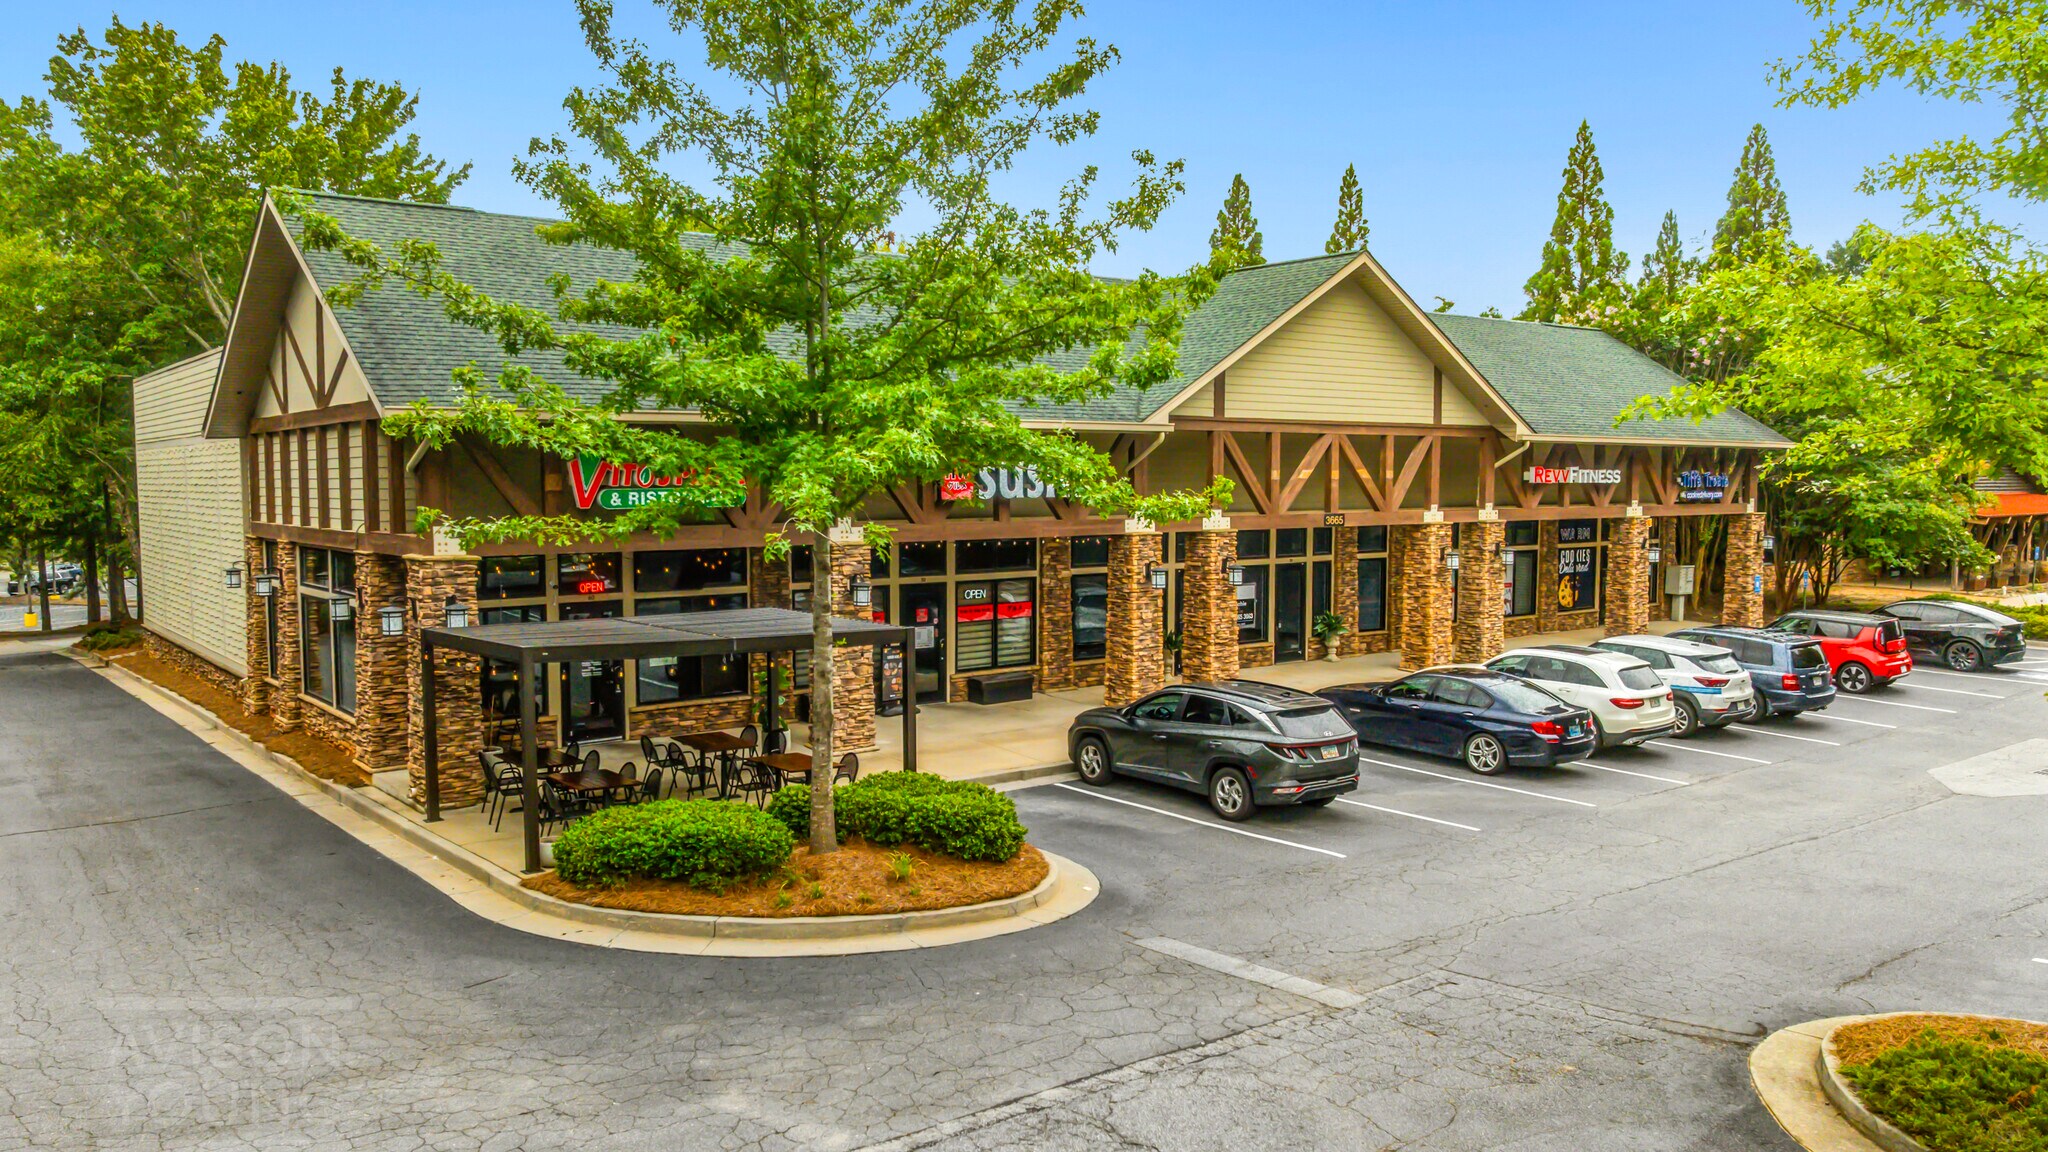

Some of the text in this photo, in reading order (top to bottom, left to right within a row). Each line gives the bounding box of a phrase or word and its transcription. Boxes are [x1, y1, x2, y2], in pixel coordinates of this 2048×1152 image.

[610, 492, 622, 506] &
[1325, 515, 1344, 525] 3665
[579, 582, 604, 593] OPEN
[964, 589, 987, 600] OPEN
